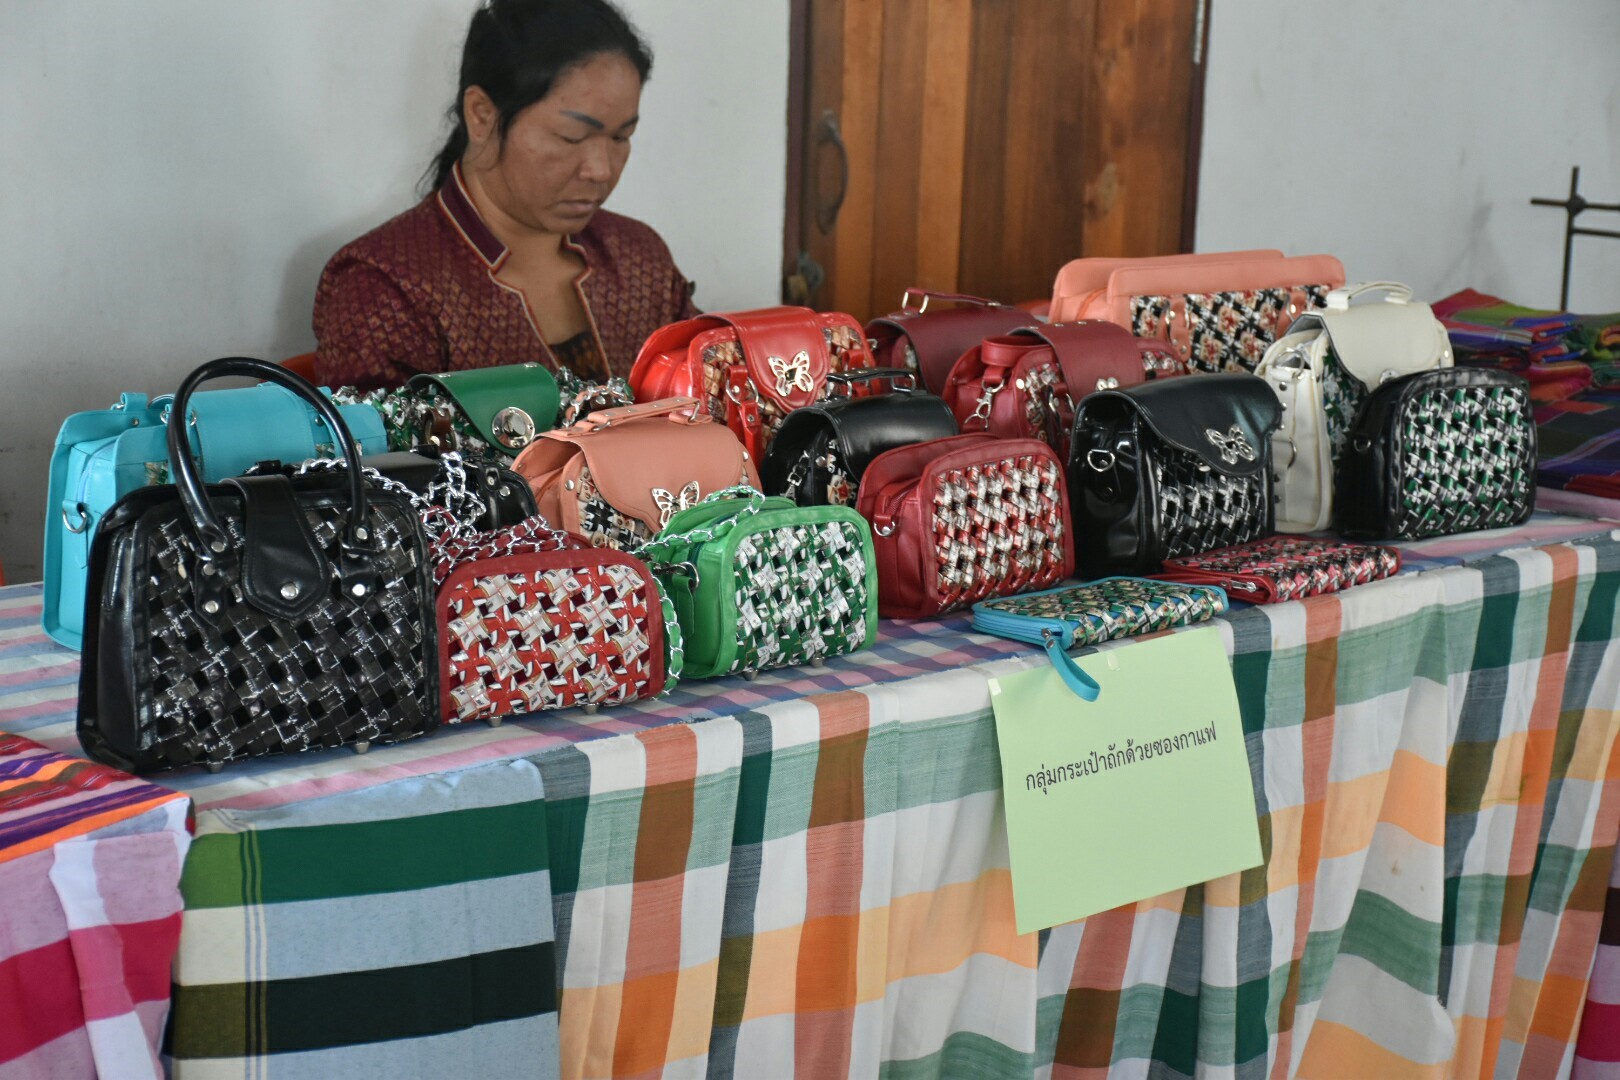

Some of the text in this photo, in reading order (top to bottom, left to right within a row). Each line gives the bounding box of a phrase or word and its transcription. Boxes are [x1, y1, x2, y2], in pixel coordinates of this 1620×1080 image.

[1025, 720, 1217, 795] กลุ่มกระเป๋าถักด้วยซองกาแฟ
